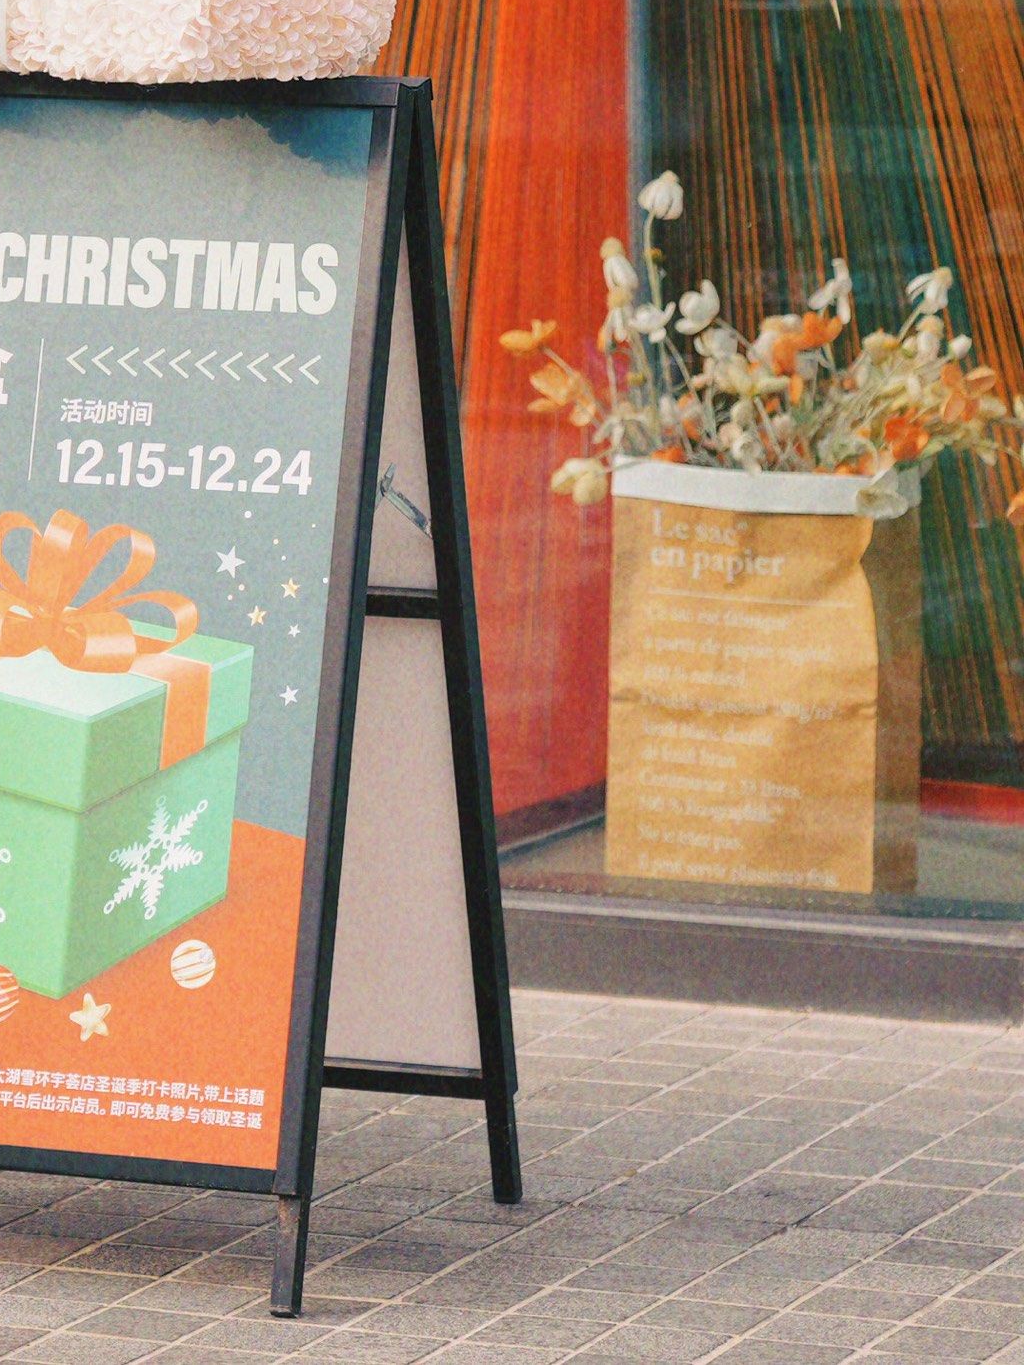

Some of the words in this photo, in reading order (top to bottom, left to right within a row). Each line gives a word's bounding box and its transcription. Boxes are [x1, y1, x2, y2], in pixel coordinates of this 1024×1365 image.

[60, 397, 154, 427] 活动时间
[56, 438, 313, 495] 12.15-12.24
[650, 546, 687, 568] en
[691, 548, 786, 584] papier
